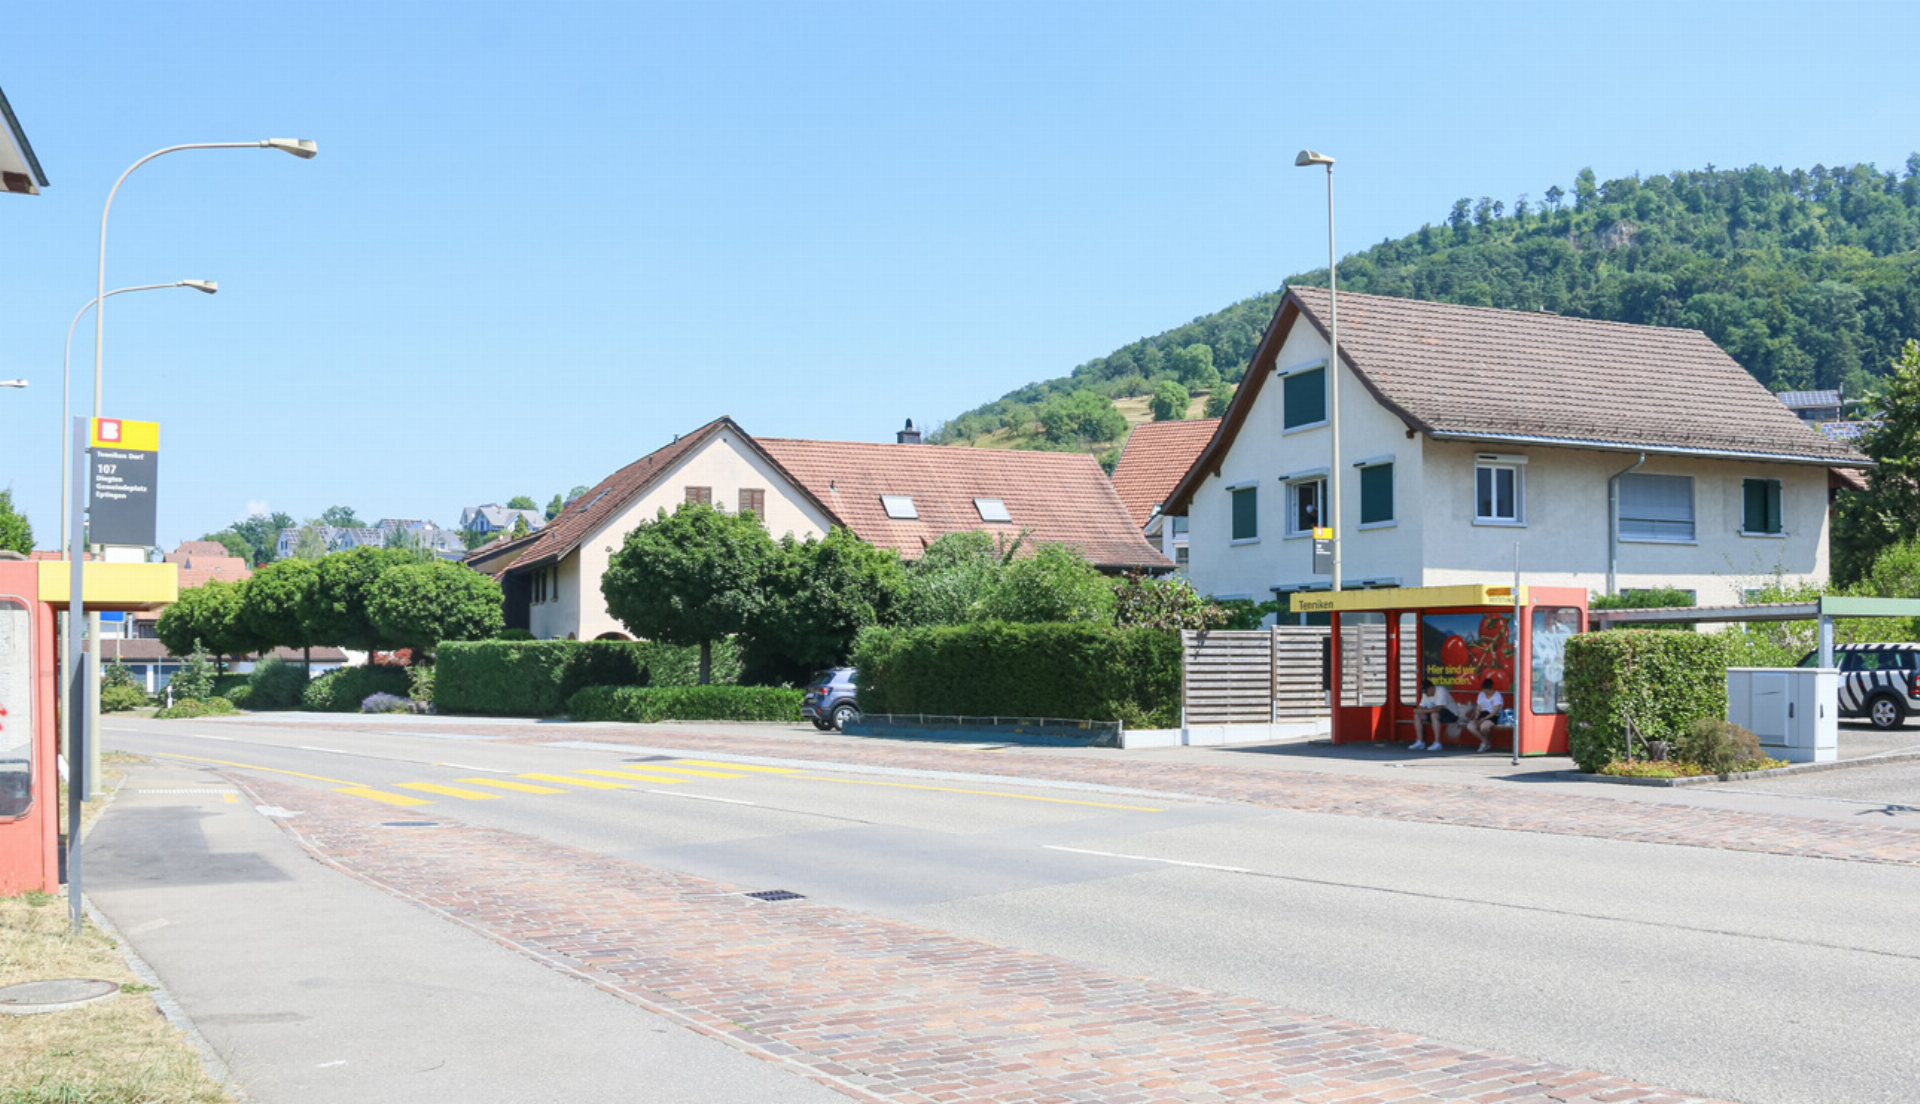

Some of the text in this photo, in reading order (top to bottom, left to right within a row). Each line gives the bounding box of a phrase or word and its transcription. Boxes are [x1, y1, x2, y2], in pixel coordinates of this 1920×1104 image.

[97, 464, 117, 474] 107
[96, 475, 123, 484] Diegten
[96, 483, 148, 493] Gemeindeplatz
[96, 491, 127, 500] Eptingen
[1298, 599, 1334, 611] Tenniken
[1427, 664, 1475, 674] Hier sind wir
